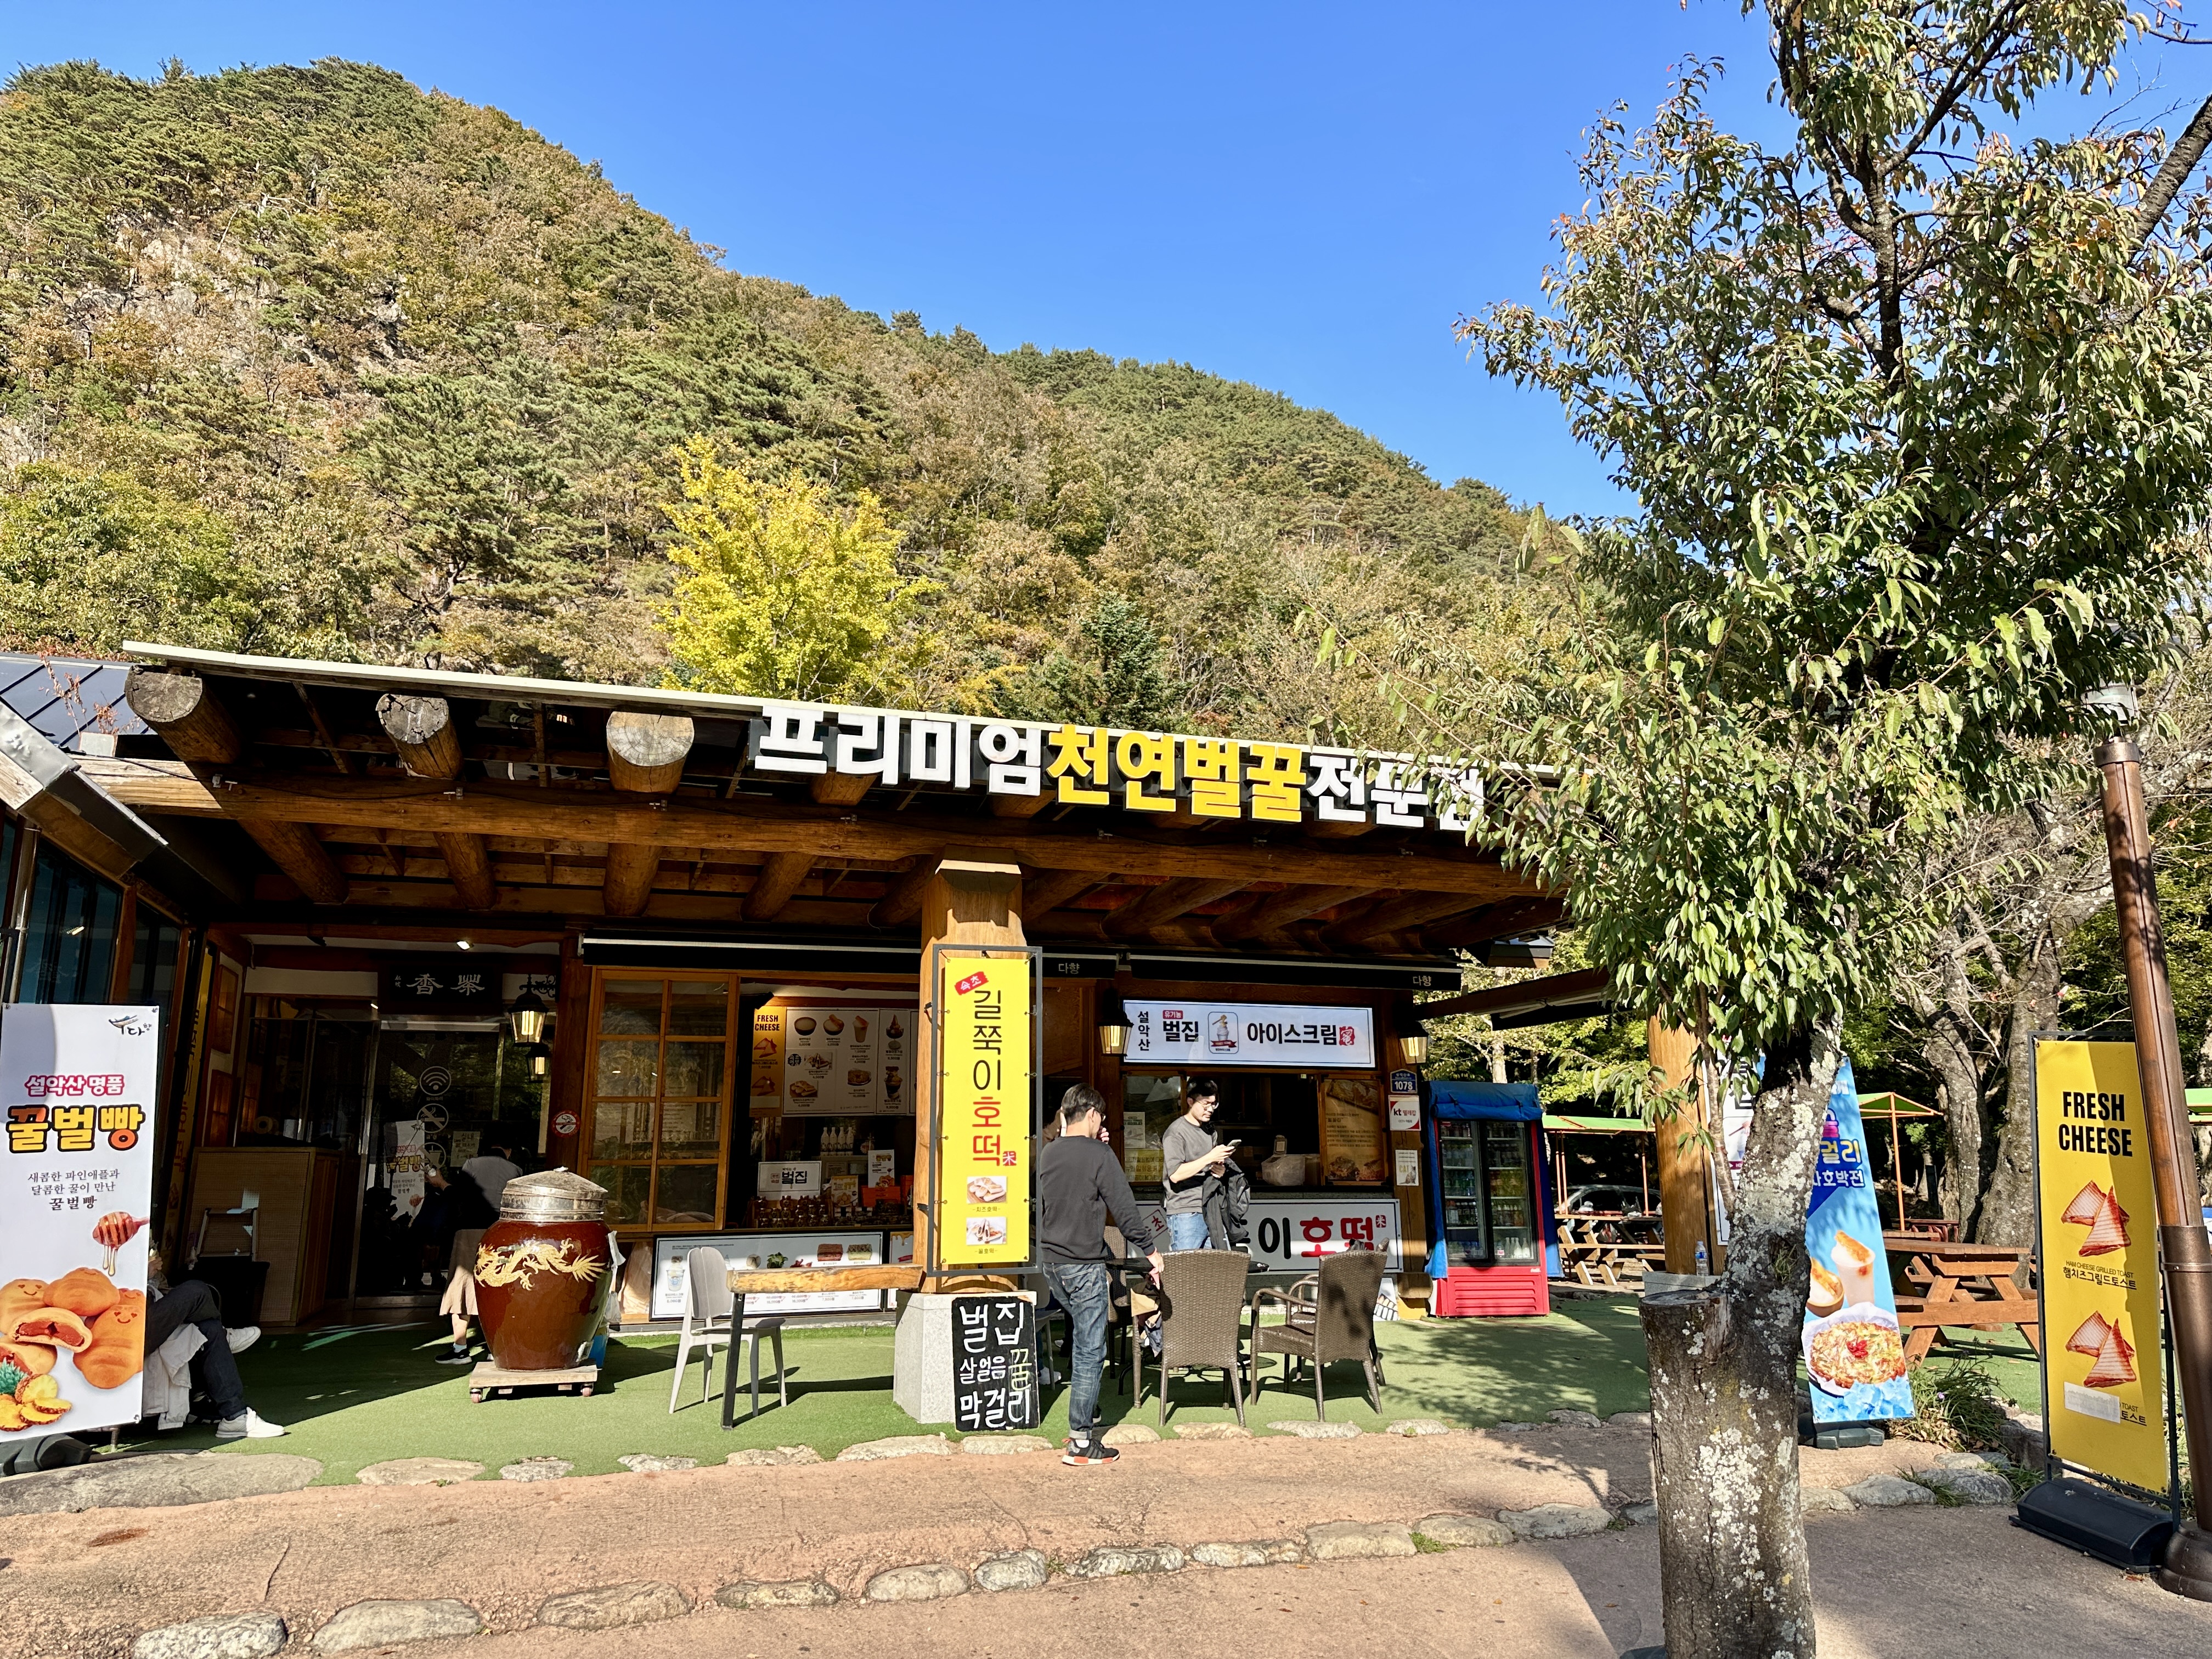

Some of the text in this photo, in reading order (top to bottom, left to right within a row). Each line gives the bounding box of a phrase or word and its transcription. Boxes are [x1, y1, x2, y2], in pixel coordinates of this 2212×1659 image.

[1058, 963, 1080, 974] 다향
[1413, 975, 1432, 987] 다향
[1137, 1011, 1150, 1051] 설악산
[1163, 1020, 1338, 1046] 벌집 아이스크림
[25, 1074, 125, 1097] 설악산 명품
[972, 990, 1003, 1167] 길쭉이호떡
[1394, 1081, 1413, 1090] 1078
[2063, 1091, 2125, 1121] FRESH
[6, 1104, 146, 1153] 꿀벌빵
[2059, 1124, 2133, 1157] CHEESE
[1821, 1140, 1861, 1164] 걸리
[28, 1169, 120, 1182] 새콤한 파인애플과
[782, 1171, 807, 1184] 벌집
[31, 1182, 116, 1196] 달콤한 꿀이 만난
[49, 1195, 98, 1211] 꿀벌빵
[2063, 1266, 2137, 1290] 햄치즈그릴드토스트
[2077, 1262, 2095, 1272] CHEESE
[2096, 1266, 2117, 1276] GRILLED
[2117, 1269, 2134, 1279] TOAST
[960, 1302, 1024, 1353] 벌집
[960, 1348, 1032, 1391] 살얼음 꿀
[960, 1387, 1030, 1429] 막걸리
[2121, 1402, 2139, 1413] TOAST
